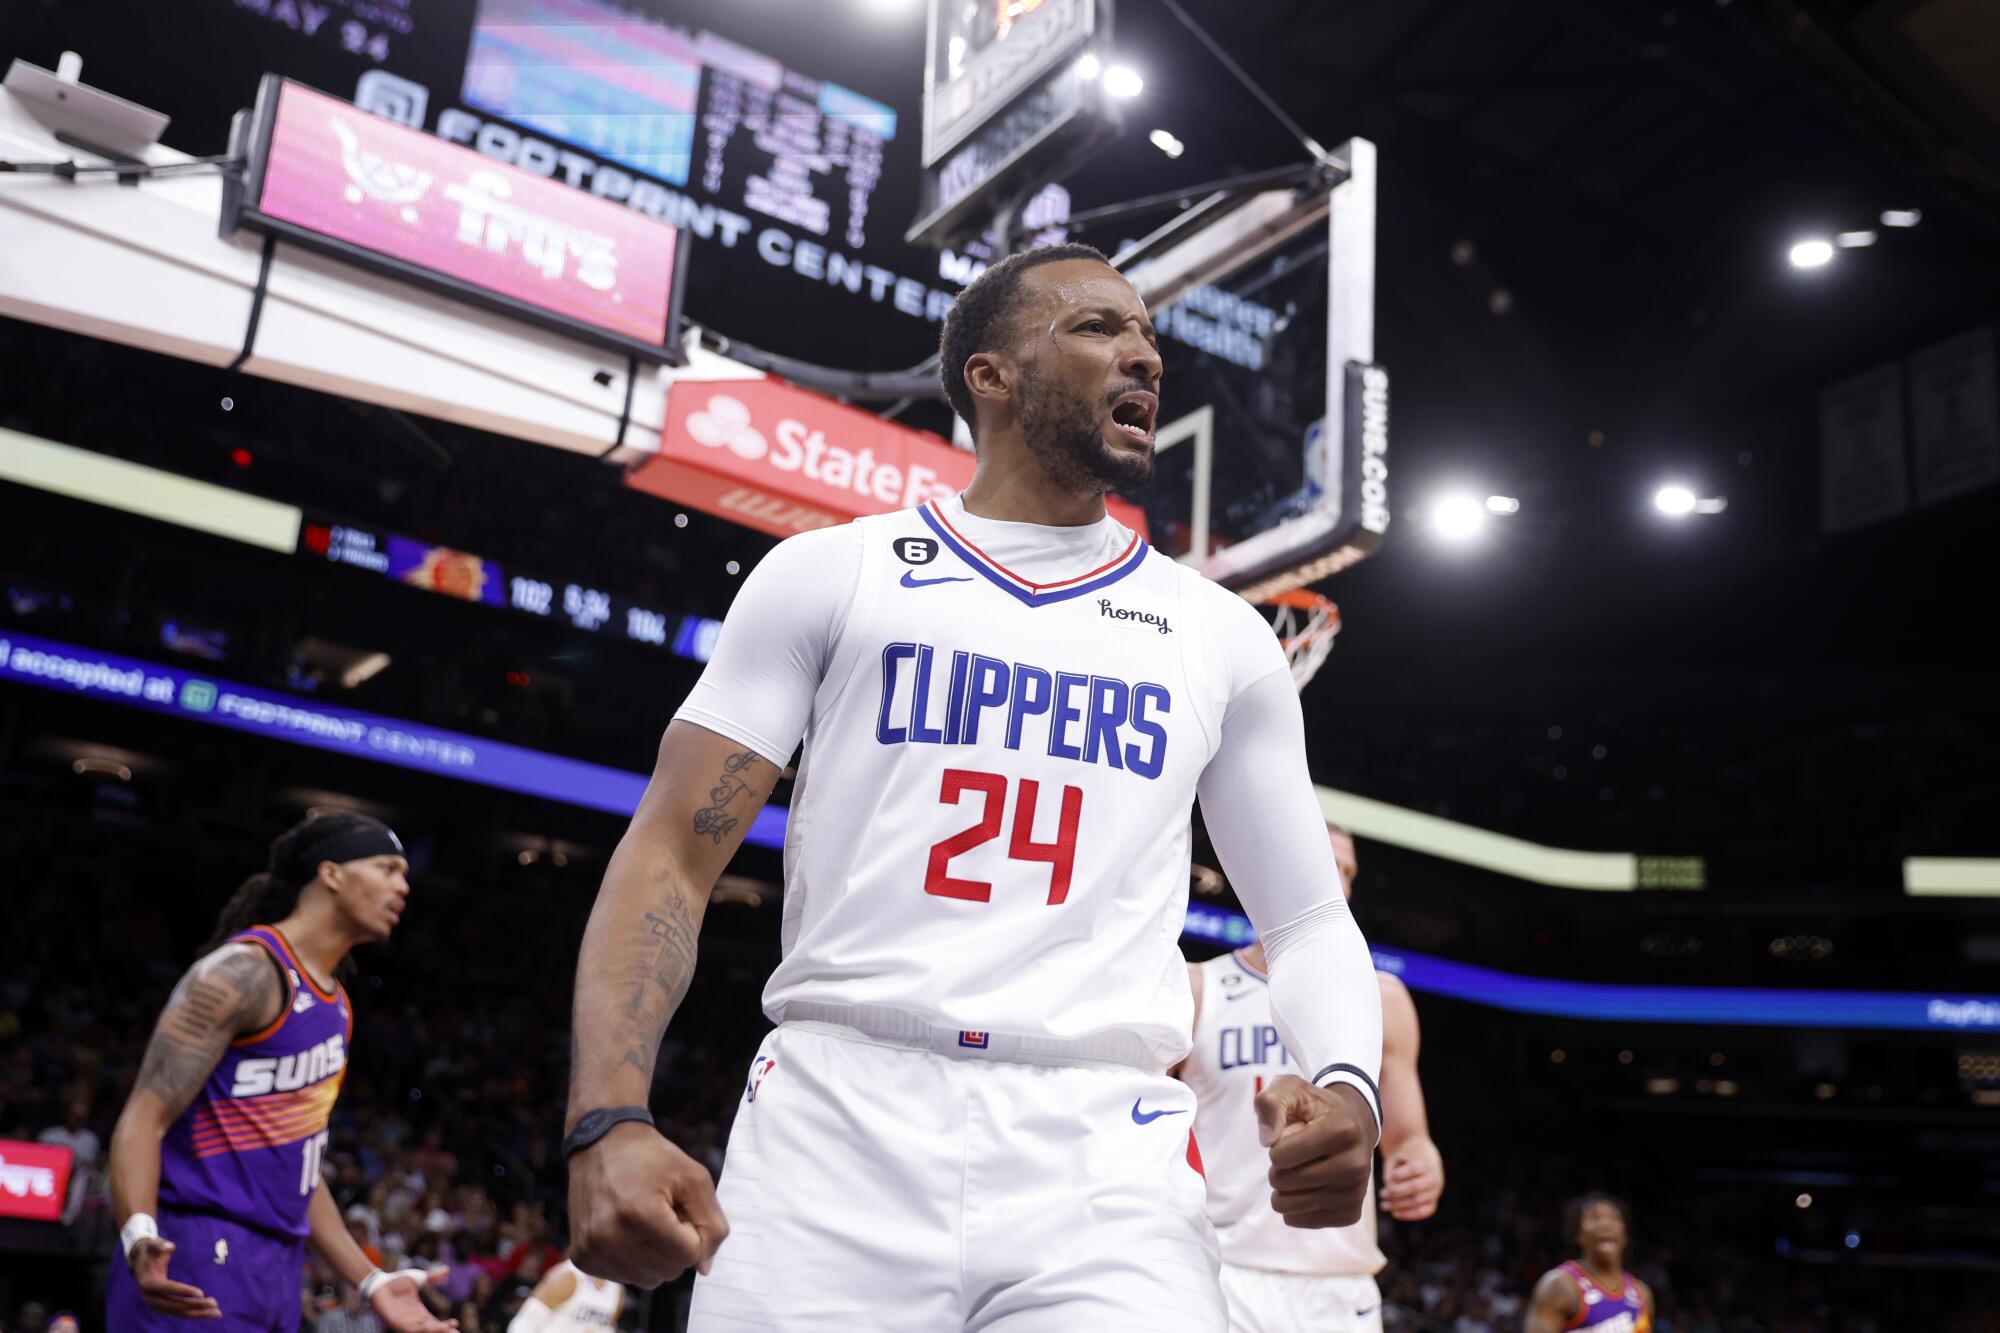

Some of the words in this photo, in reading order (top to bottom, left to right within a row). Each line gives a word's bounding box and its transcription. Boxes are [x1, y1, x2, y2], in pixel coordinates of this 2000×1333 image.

[437, 108, 750, 248] FOOTPRINT
[757, 228, 956, 322] CENTER
[769, 419, 903, 505] State
[903, 463, 960, 507] Fa
[904, 541, 928, 562] 6
[1098, 598, 1172, 634] honey
[10, 648, 144, 696] accepted
[143, 676, 175, 704] at
[217, 693, 367, 743] FOOTPRINT
[367, 726, 475, 767] CENTER
[876, 642, 1172, 780] CLIPPERS
[924, 768, 1084, 905] 24
[231, 1033, 344, 1097] SUNS
[1220, 1026, 1287, 1070] CLIP
